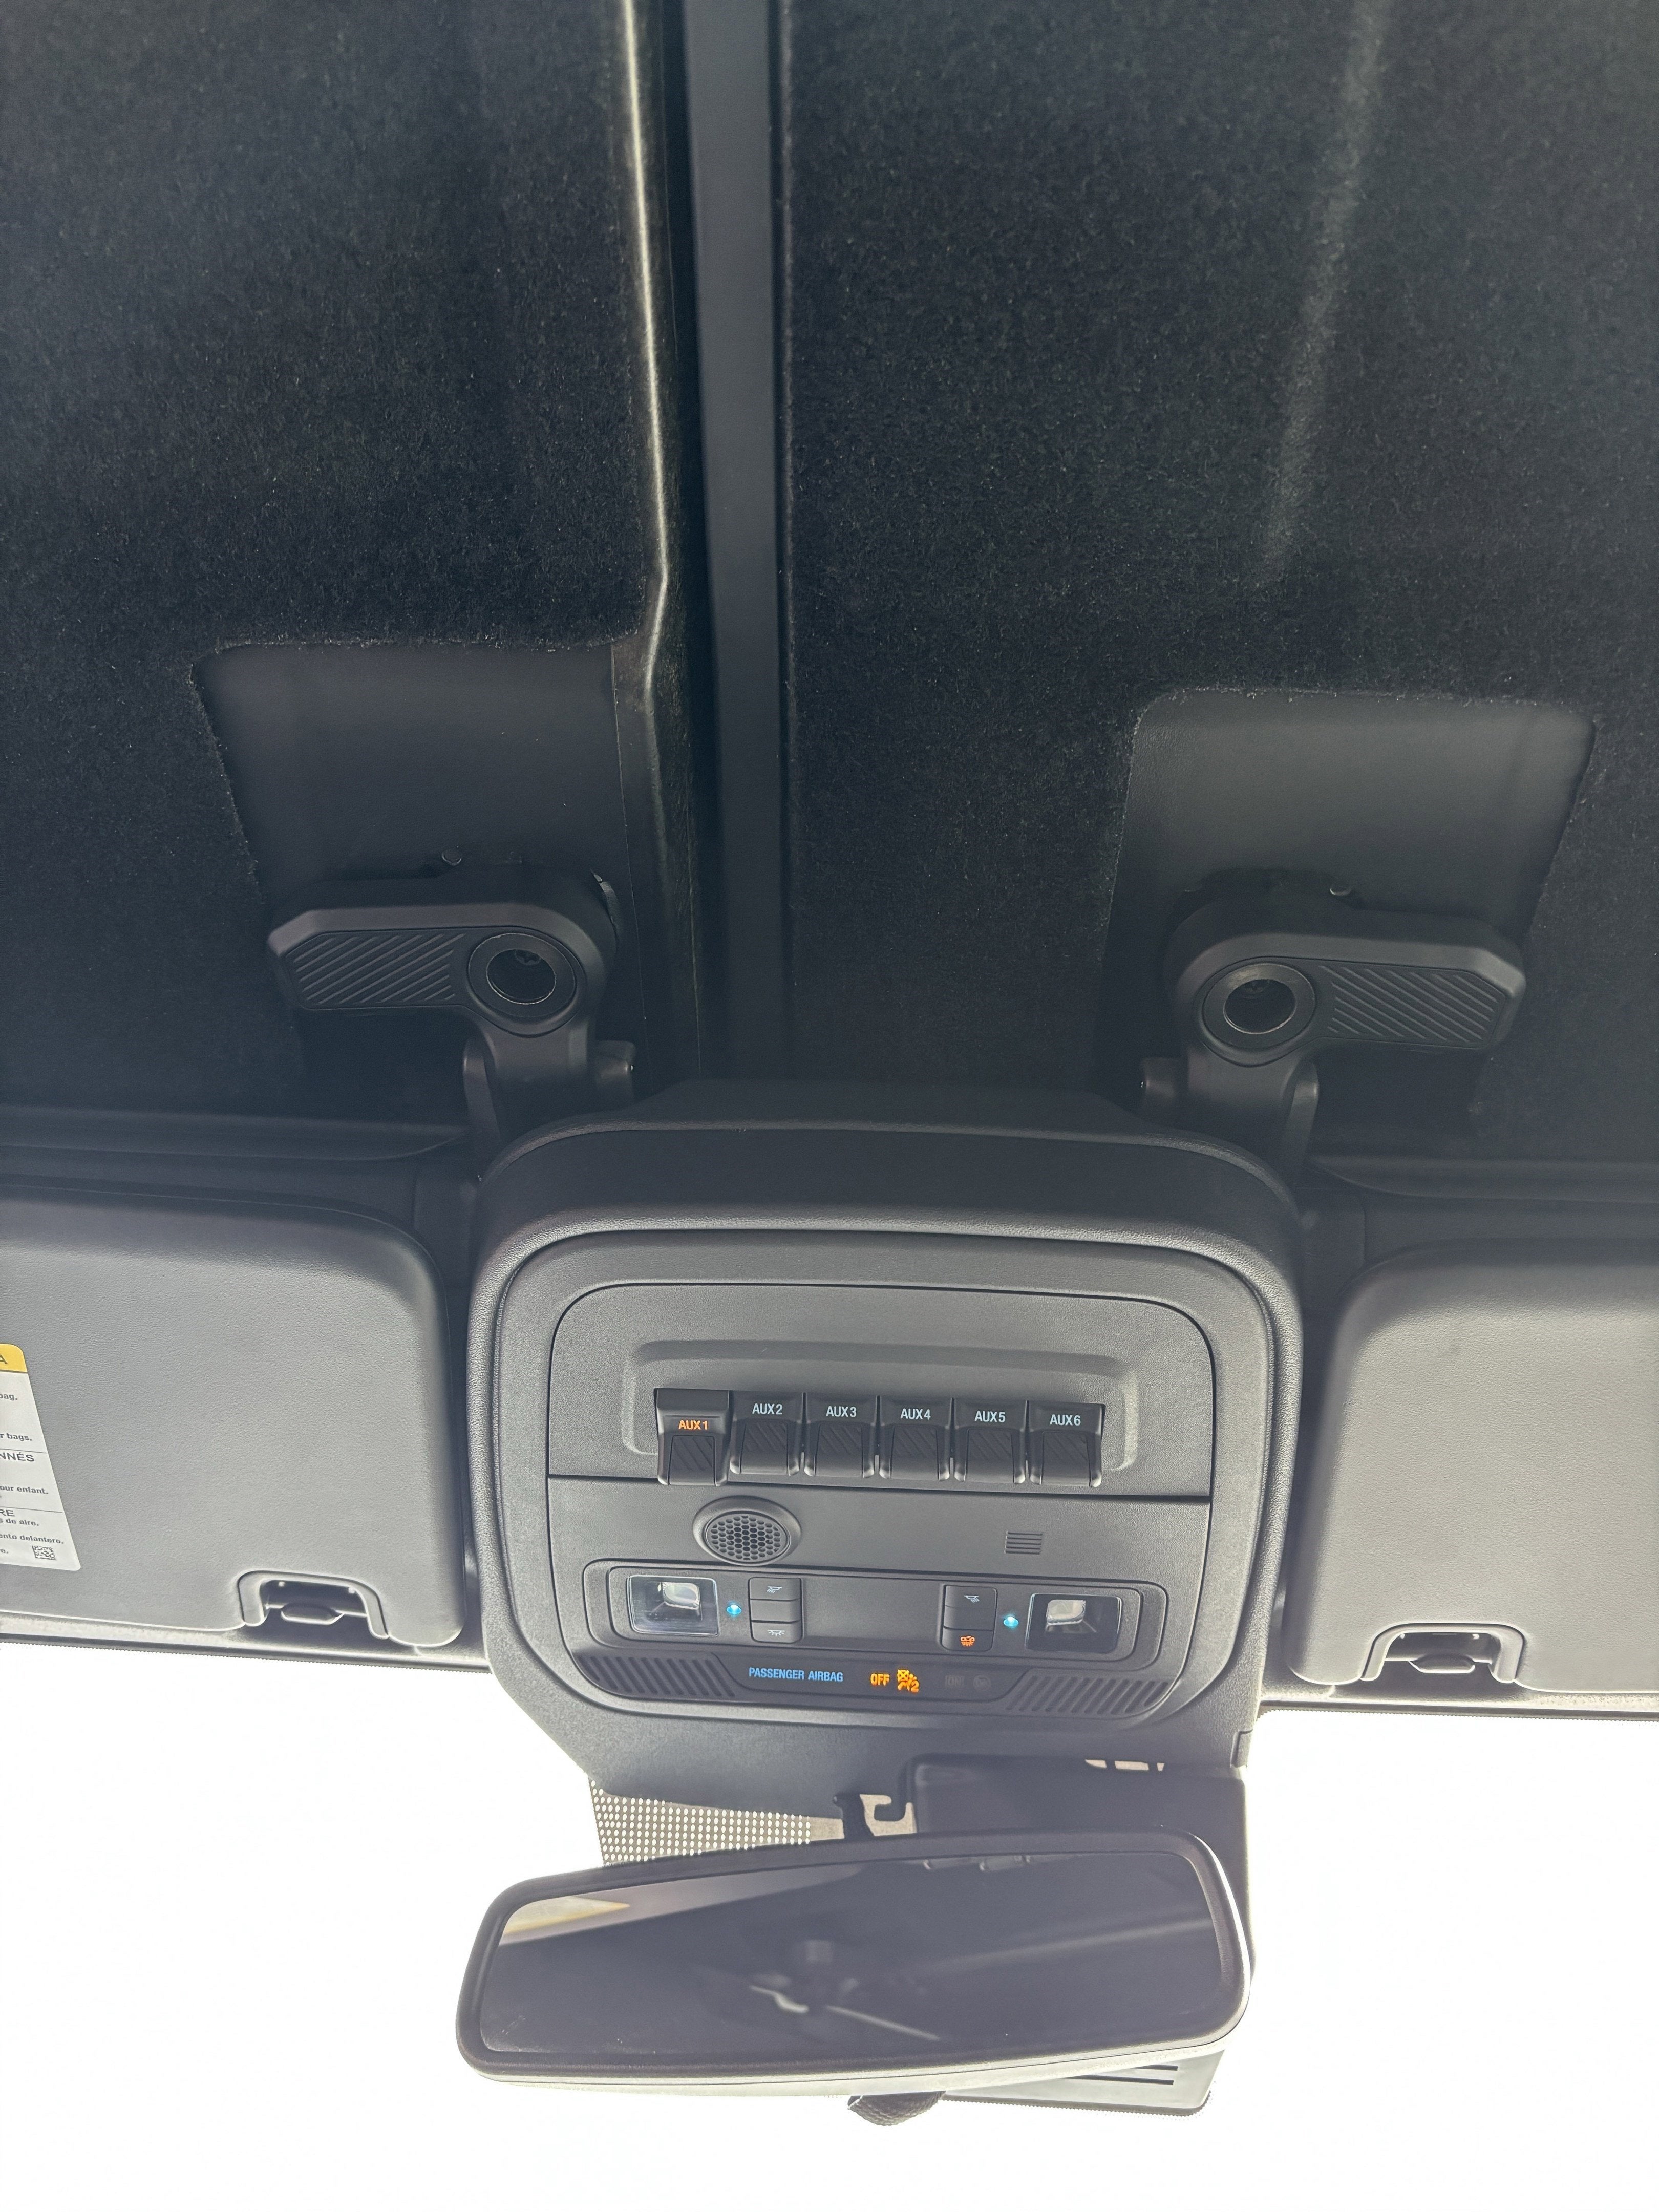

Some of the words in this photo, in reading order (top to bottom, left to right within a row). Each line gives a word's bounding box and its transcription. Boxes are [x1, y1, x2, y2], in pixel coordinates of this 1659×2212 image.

[7, 1433, 32, 1441] bags.
[19, 1535, 64, 1544] delantero.
[749, 1667, 804, 1680] PASSENGER
[807, 1670, 843, 1682] AIRBAG
[870, 1673, 890, 1686] OFF
